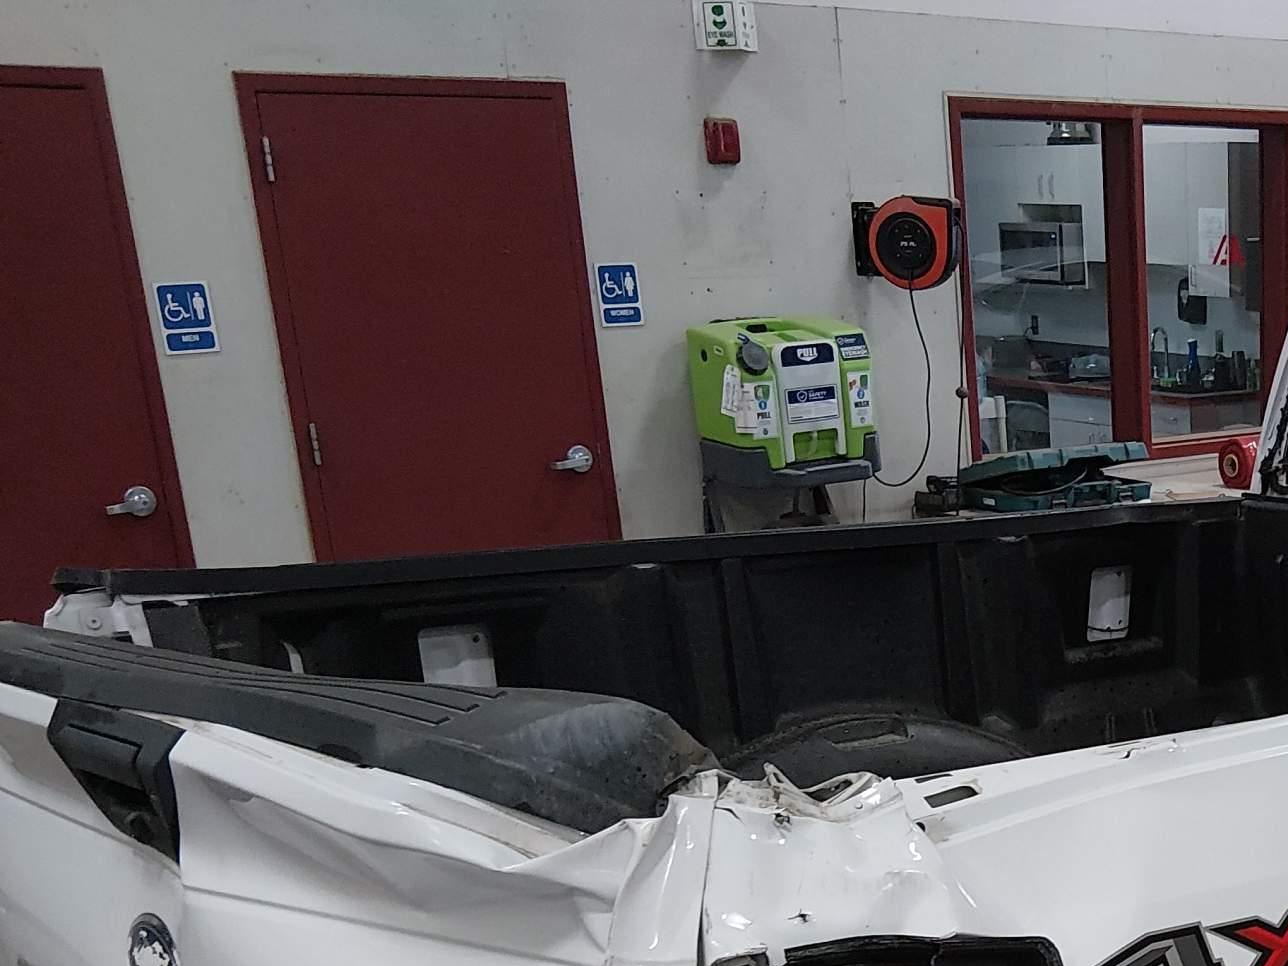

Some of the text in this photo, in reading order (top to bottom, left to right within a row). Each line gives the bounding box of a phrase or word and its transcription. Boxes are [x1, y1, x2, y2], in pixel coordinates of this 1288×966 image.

[609, 309, 635, 317] WOMEN
[181, 333, 200, 343] MEN
[796, 347, 818, 359] PULL
